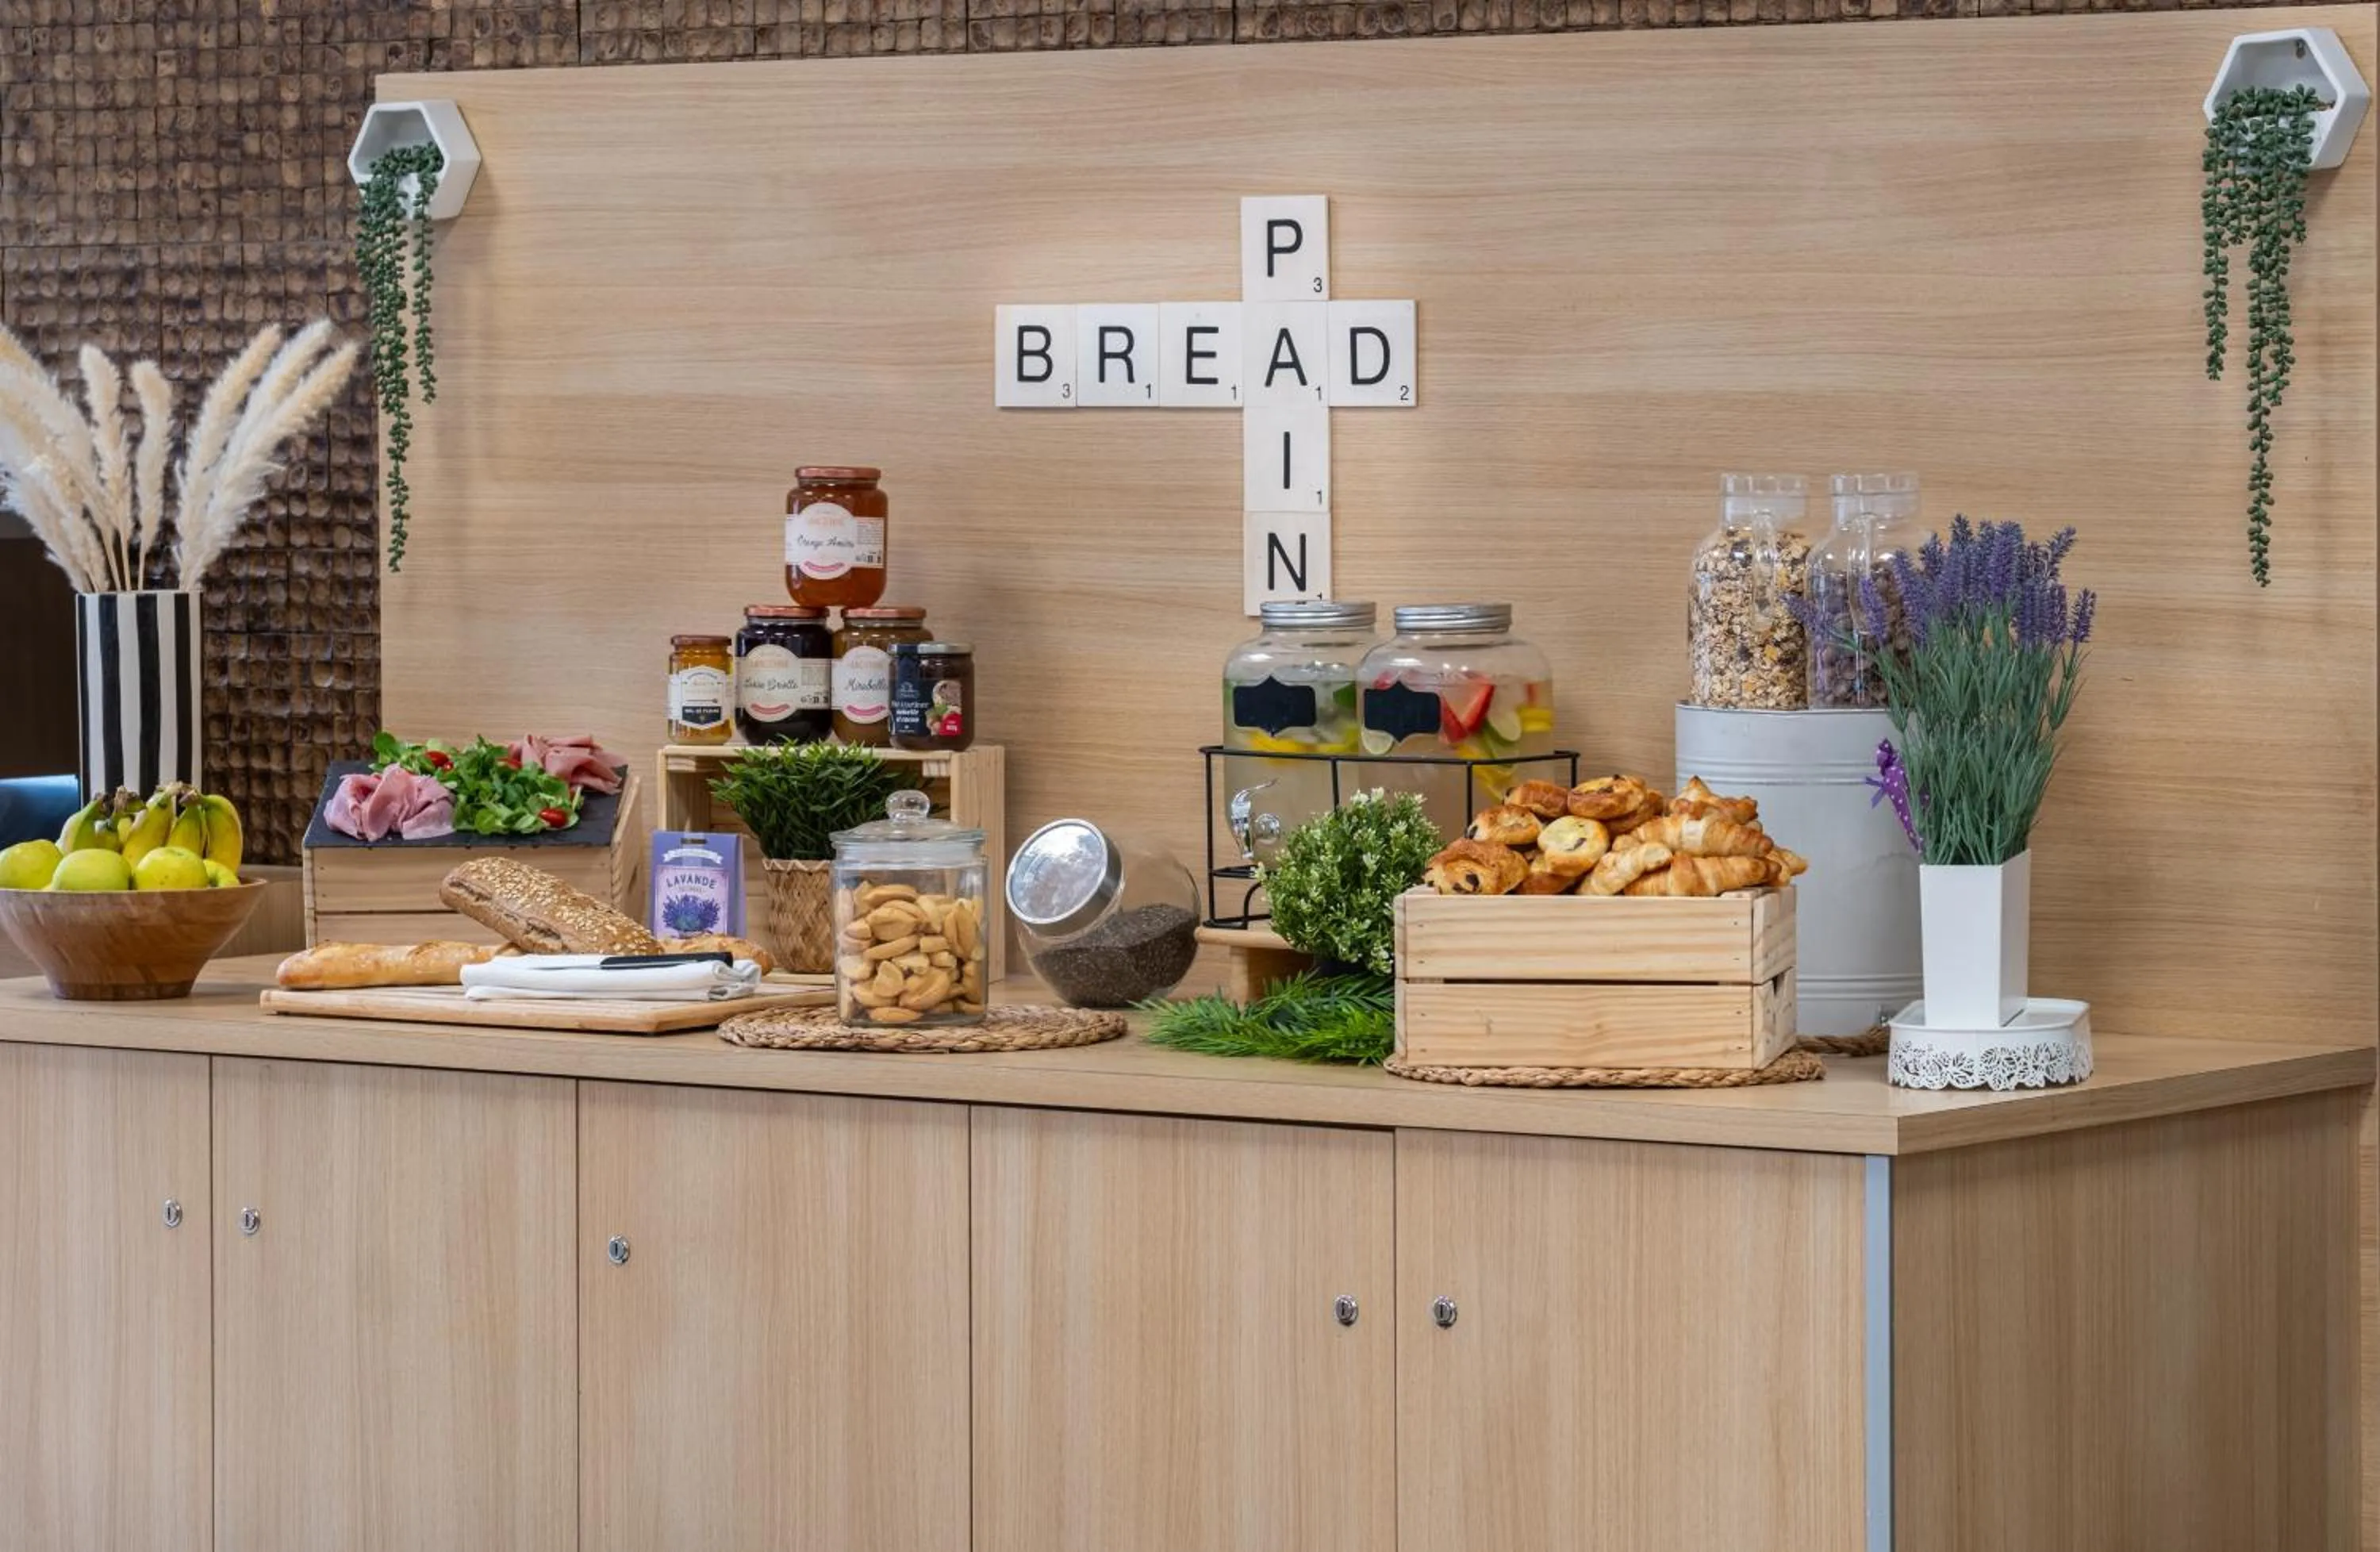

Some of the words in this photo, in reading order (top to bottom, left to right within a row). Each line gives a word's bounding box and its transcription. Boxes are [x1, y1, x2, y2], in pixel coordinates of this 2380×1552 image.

[1313, 278, 1323, 293] 3
[1017, 325, 1392, 387] BREAD
[1061, 384, 1071, 399] 3
[1145, 384, 1153, 399] 1
[1230, 386, 1238, 401] 1
[1315, 386, 1322, 401] 1
[1399, 386, 1410, 401] 2
[1265, 219, 1307, 592] PAIN
[1316, 490, 1323, 505] 1
[666, 874, 717, 889] LAVANDE
